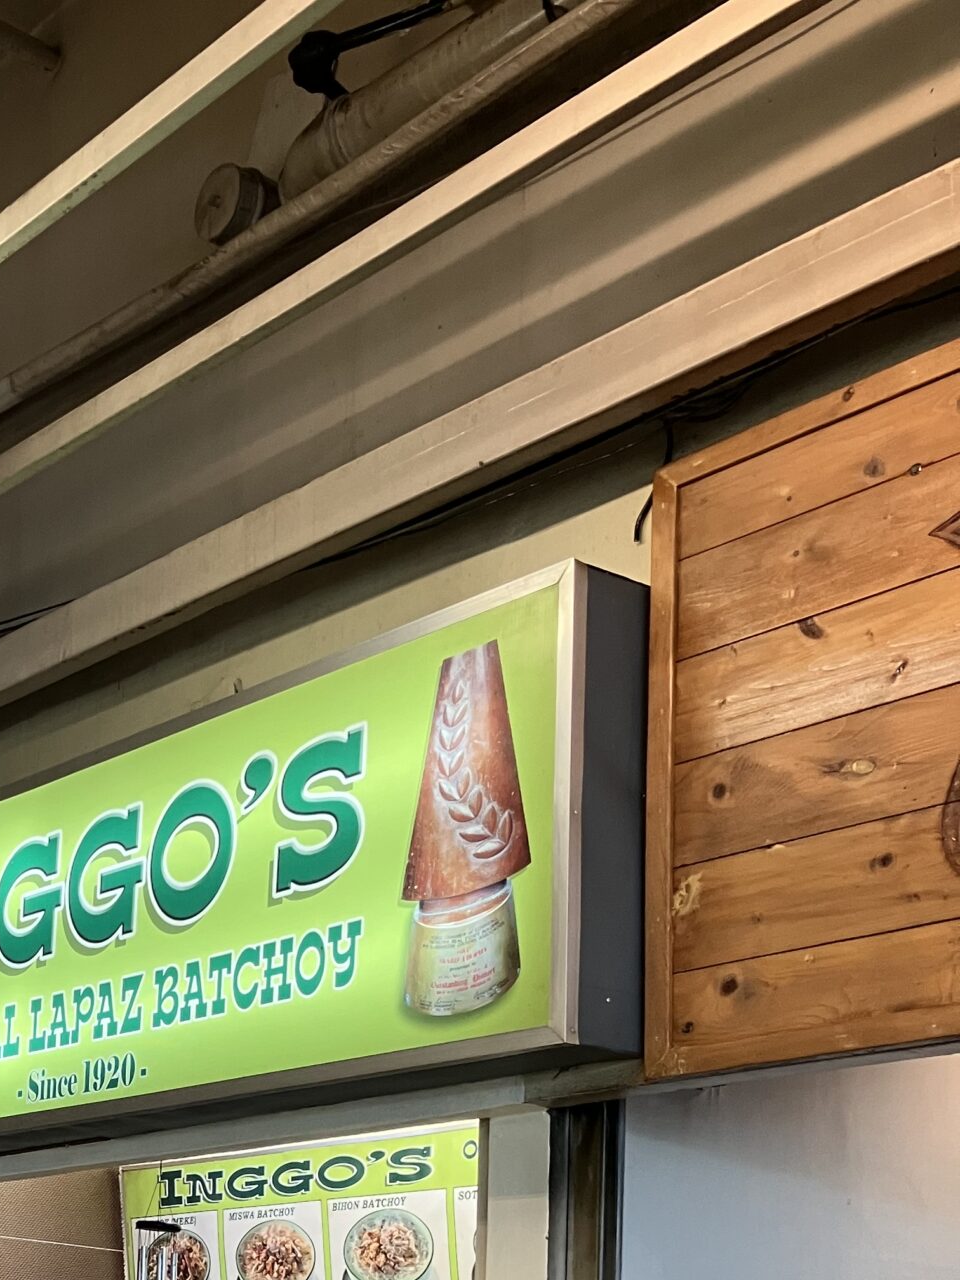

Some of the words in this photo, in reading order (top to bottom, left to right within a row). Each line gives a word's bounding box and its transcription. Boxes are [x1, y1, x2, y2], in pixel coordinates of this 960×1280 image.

[28, 972, 144, 1054] LAPAZ
[152, 918, 363, 1029] BATCHOY
[27, 1066, 78, 1104] Since
[81, 1052, 136, 1097] 1920
[228, 1210, 255, 1221] MISWA
[256, 1206, 296, 1219] BATCHOY
[332, 1199, 360, 1212] BIHON
[362, 1196, 407, 1209] BATCHOY
